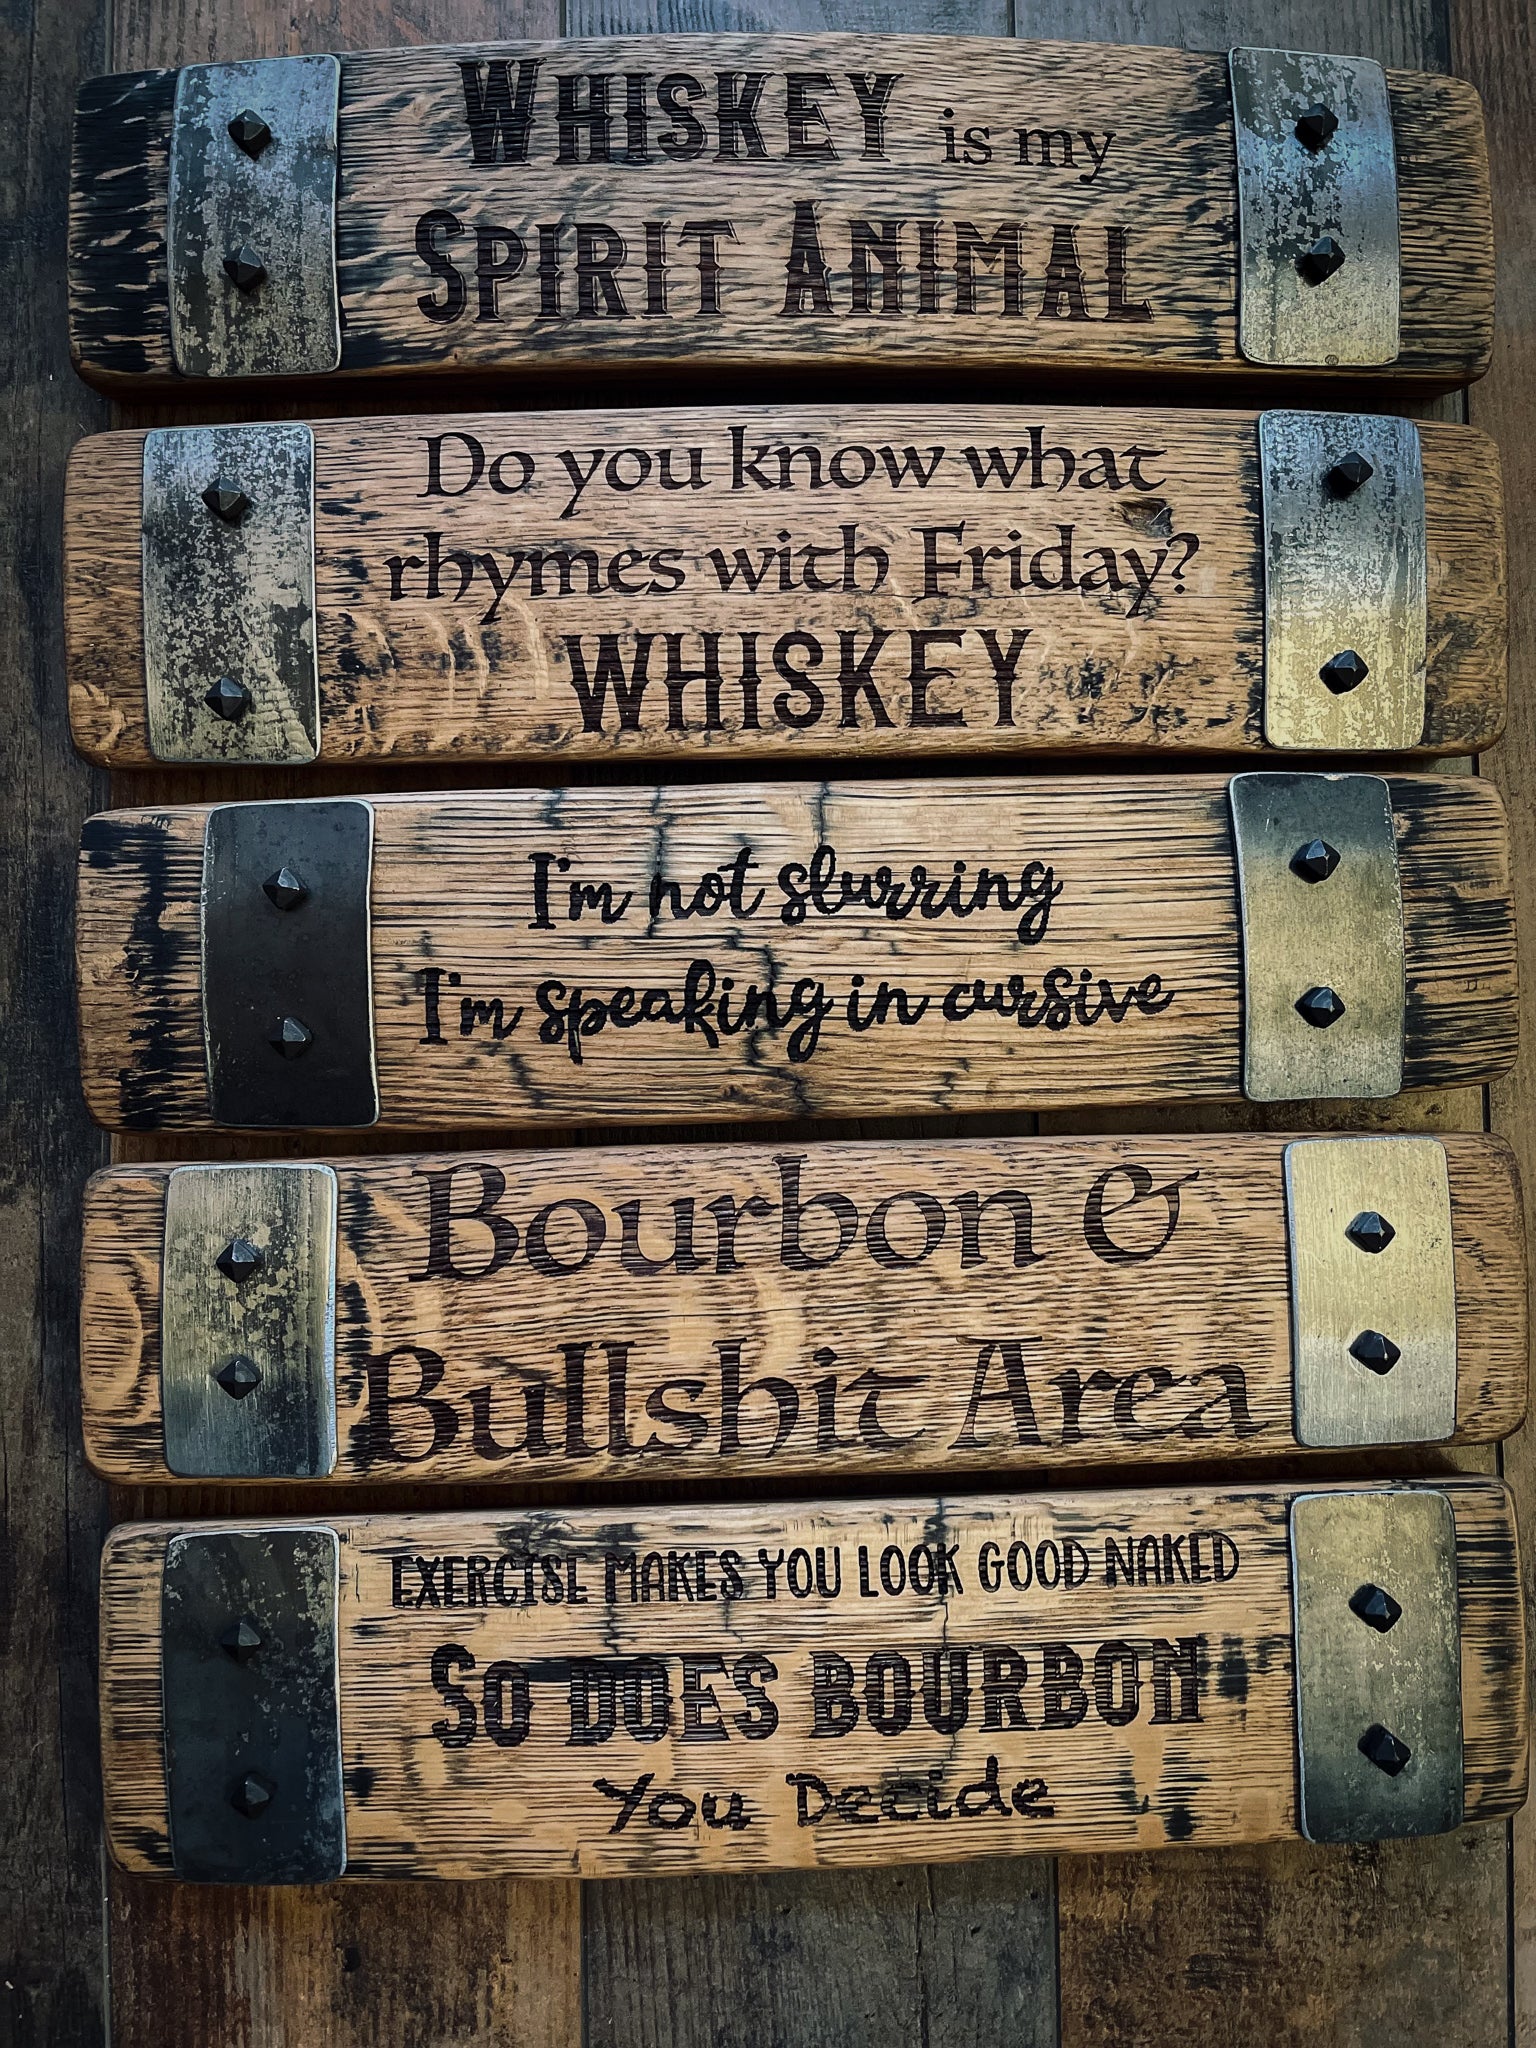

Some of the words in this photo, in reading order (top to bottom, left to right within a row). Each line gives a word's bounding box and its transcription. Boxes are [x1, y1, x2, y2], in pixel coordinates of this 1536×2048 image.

[459, 57, 905, 167] WHISKEY
[943, 108, 993, 165] is
[1015, 127, 1117, 183] my
[414, 208, 743, 323] SPIRIT
[779, 200, 1155, 321] ANIMAL
[416, 431, 535, 499] Do
[554, 445, 711, 519] you
[730, 425, 946, 491] know
[962, 425, 1167, 493] what
[382, 531, 686, 625] rhymes
[710, 524, 890, 593] with
[911, 520, 1200, 618] Friday?
[561, 628, 1034, 734] WHISKEY
[527, 852, 632, 930] I'm
[649, 847, 766, 921] not
[778, 845, 1065, 945] slurring
[418, 968, 521, 1045] I'm
[538, 959, 834, 1064] speaking
[846, 973, 928, 1031] in
[941, 967, 1176, 1031] cursive
[409, 1153, 1047, 1283] Bourbon
[1083, 1163, 1200, 1265] &
[365, 1336, 933, 1463] Bullshit
[949, 1334, 1269, 1450] Area
[391, 1552, 588, 1609] EXERCISE
[604, 1548, 745, 1603] MAKES
[756, 1546, 841, 1599] YOU
[858, 1543, 964, 1598] LOOK
[979, 1538, 1090, 1592] GOOD
[1104, 1531, 1240, 1587] NAKED
[430, 1643, 534, 1748] SO
[565, 1652, 779, 1743] DOES
[809, 1635, 1206, 1739] BOURBON
[593, 1772, 751, 1834] You
[786, 1755, 1056, 1827] Decide
